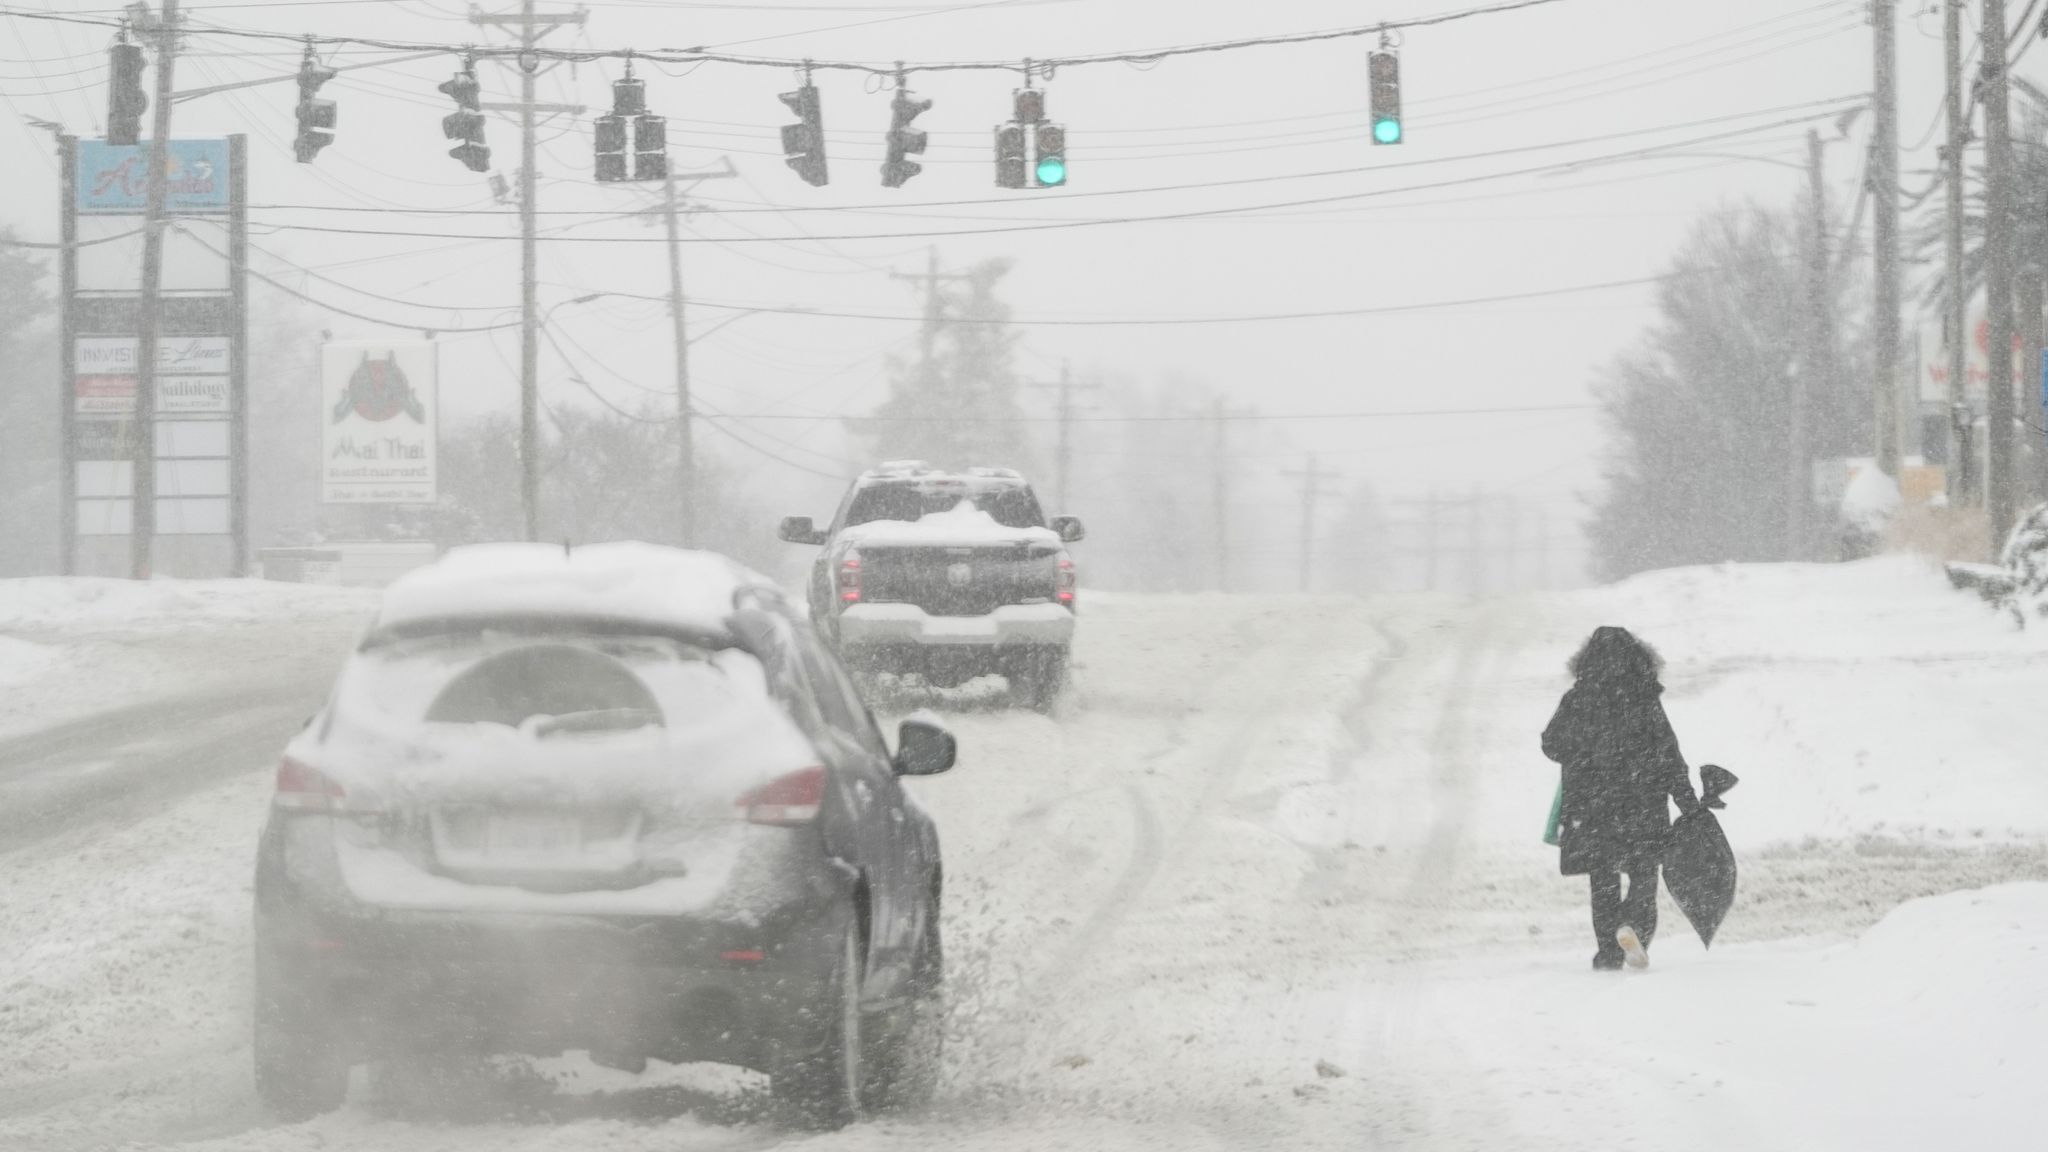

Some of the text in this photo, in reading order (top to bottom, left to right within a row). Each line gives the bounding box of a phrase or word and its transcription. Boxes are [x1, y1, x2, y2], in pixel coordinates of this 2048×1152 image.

[331, 434, 427, 460] Mai Thai
[329, 465, 428, 478] Restaurant
